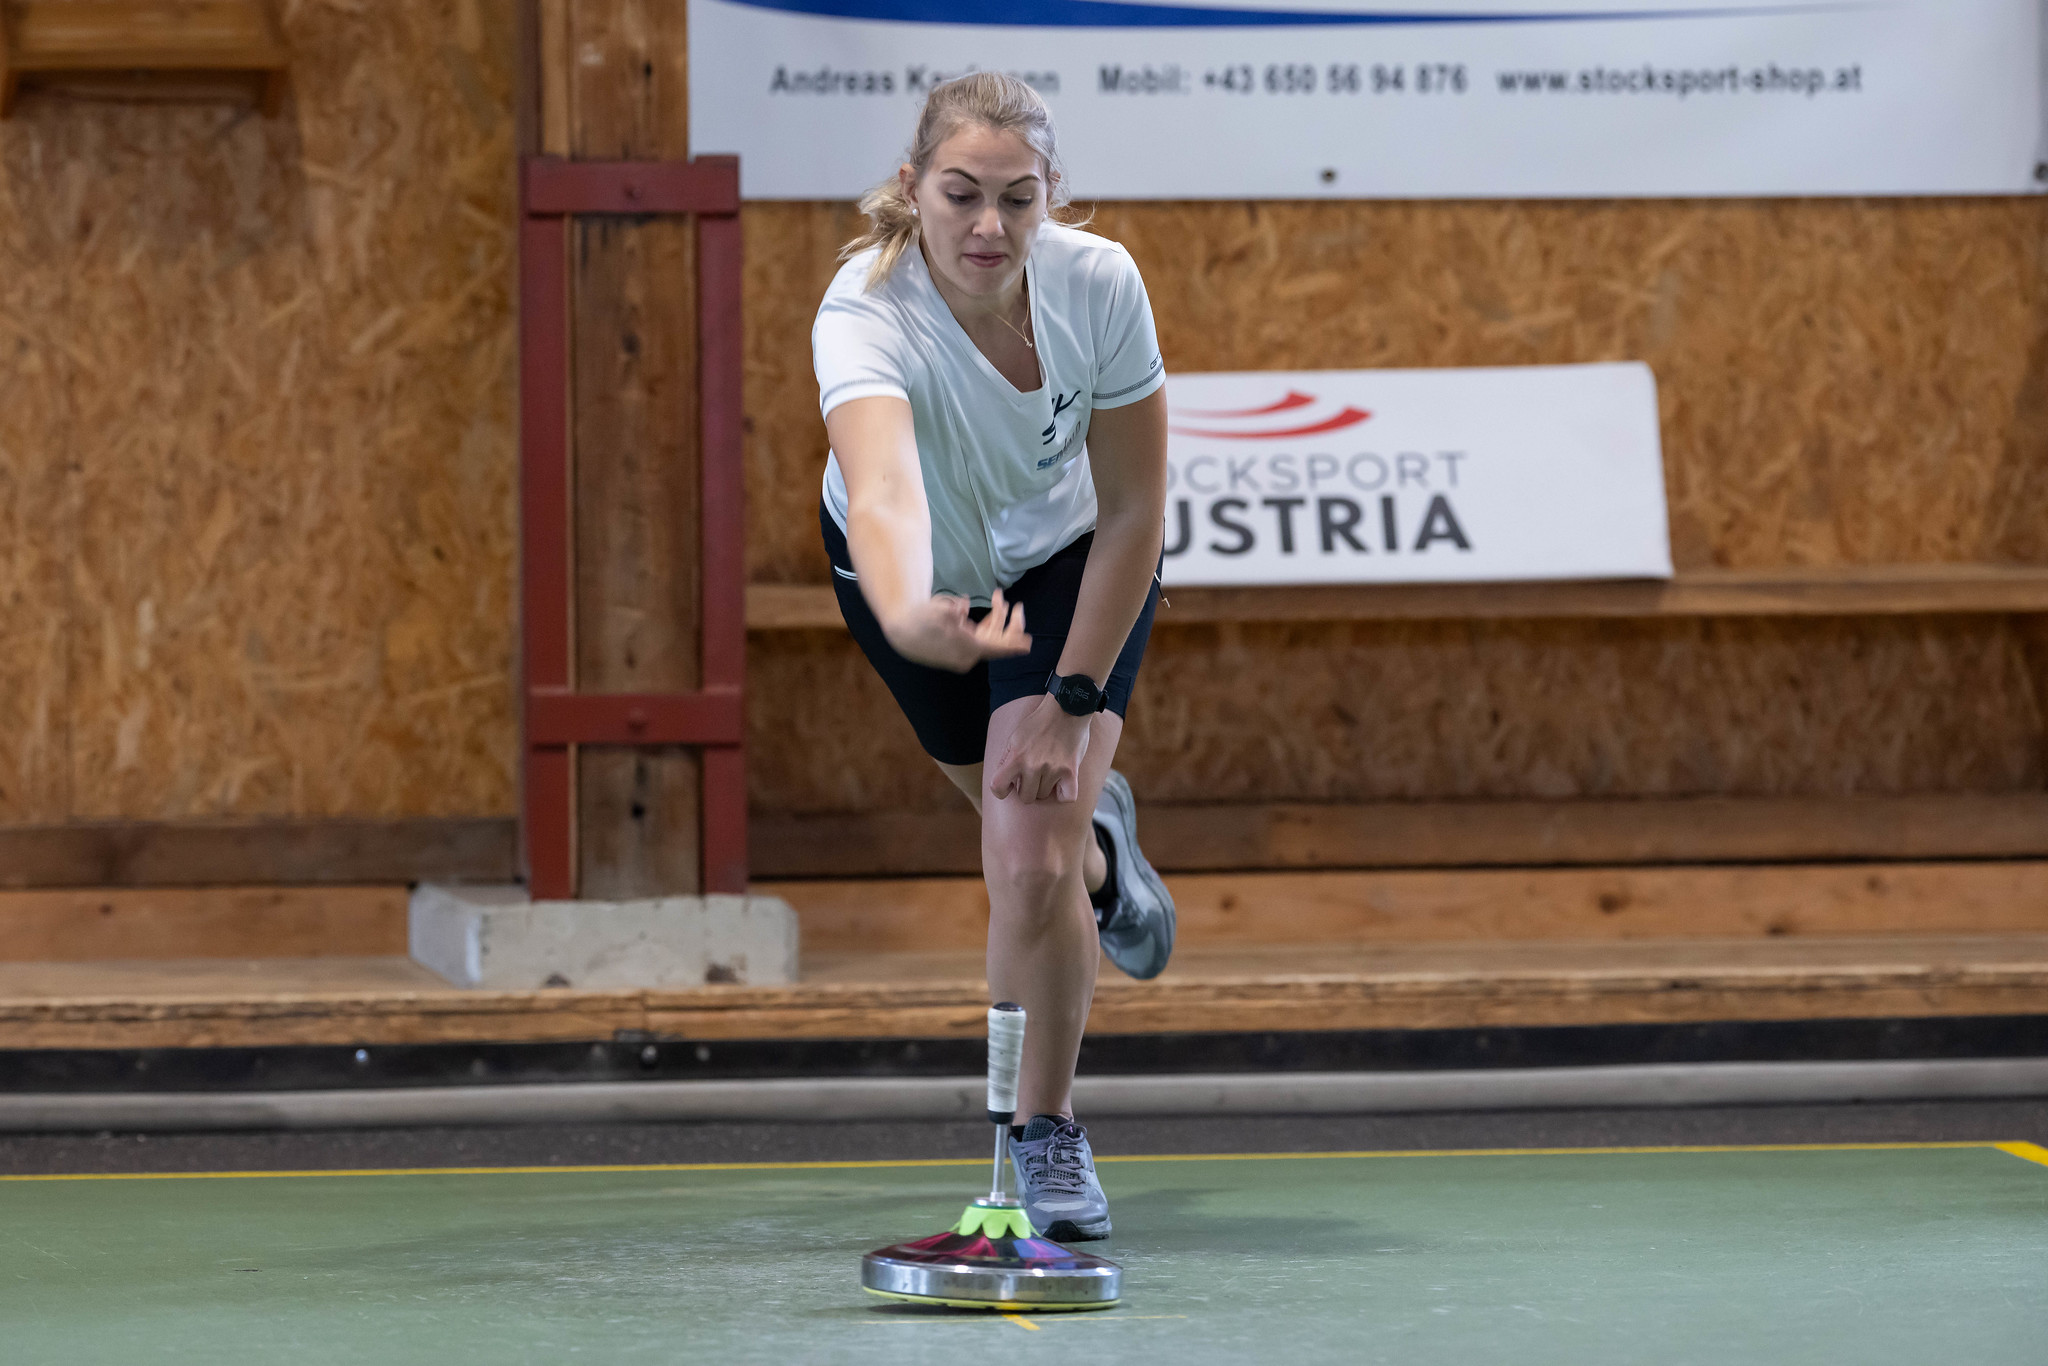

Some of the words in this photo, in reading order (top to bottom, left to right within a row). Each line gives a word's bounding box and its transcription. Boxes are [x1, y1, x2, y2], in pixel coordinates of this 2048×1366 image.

[771, 65, 895, 93] Andreas
[1098, 64, 1190, 94] Mobil:
[1204, 64, 1254, 94] +43
[1264, 64, 1316, 94] 650
[1327, 64, 1360, 94] 56
[1371, 64, 1404, 94] 94
[1415, 64, 1467, 94] 876
[1496, 64, 1863, 98] www.stocksport-shop.at
